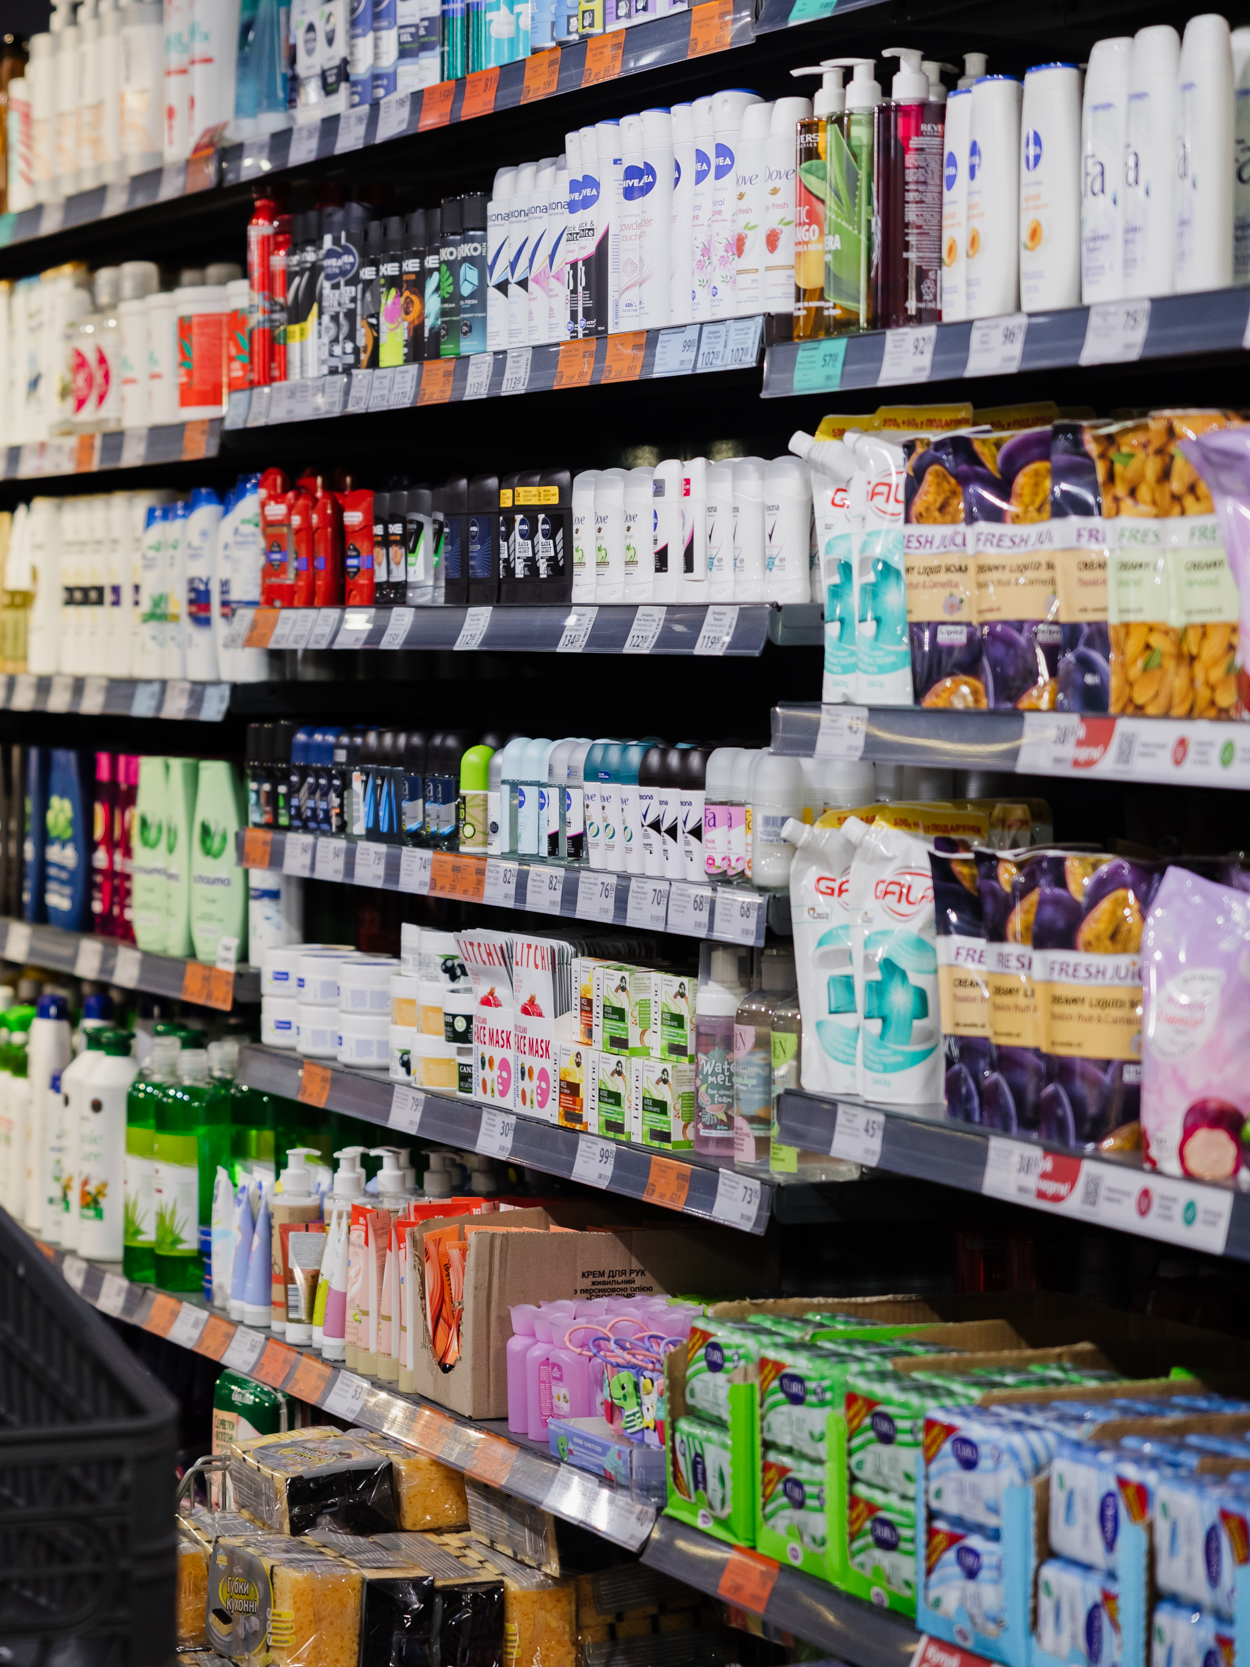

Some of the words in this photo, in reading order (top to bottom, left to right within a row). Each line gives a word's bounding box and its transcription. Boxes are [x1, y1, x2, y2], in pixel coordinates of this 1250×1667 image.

[921, 123, 943, 133] REVE
[695, 162, 708, 171] VEA
[764, 165, 796, 183] Dove
[1083, 152, 1105, 198] Fa
[582, 188, 598, 198] VEA
[509, 208, 528, 219] exona
[528, 204, 548, 215] xona
[548, 200, 569, 212] xona
[771, 202, 790, 211] fresh
[796, 205, 810, 222] TIC
[487, 212, 509, 223] exona
[580, 228, 594, 238] hite
[796, 225, 820, 243] NGO
[461, 242, 481, 257] RKO
[825, 235, 842, 251] ERA
[380, 262, 400, 276] XE
[402, 258, 420, 272] XE
[424, 254, 440, 269] XE
[359, 266, 376, 280] XE
[682, 339, 692, 353] 99
[912, 337, 925, 356] 92
[701, 351, 714, 366] 102
[730, 347, 744, 363] 102
[832, 429, 847, 437] 500
[766, 504, 780, 512] exona
[623, 509, 638, 523] Dove
[373, 524, 384, 536] XE
[1118, 526, 1161, 545] FRES
[1189, 524, 1218, 542] FRE
[905, 534, 933, 550] ESH
[975, 531, 1028, 550] FRESH
[1031, 529, 1053, 547] JUI
[1076, 561, 1107, 572] CREAM
[1022, 577, 1056, 587] amelli
[562, 634, 575, 647] 134
[629, 634, 644, 647] 122
[585, 793, 596, 802] ove
[600, 793, 611, 803] ove
[373, 851, 381, 866] 79
[418, 856, 427, 872] 74
[503, 869, 511, 884] 82
[548, 875, 557, 891] 82
[599, 881, 610, 899] 76
[651, 888, 662, 906] 70
[693, 894, 704, 912] 68
[740, 900, 751, 918] 68
[456, 939, 502, 967] LITCHI
[515, 942, 550, 972] LITCHI
[955, 946, 987, 964] FRE
[1050, 960, 1107, 980] FRESH
[953, 977, 988, 988] CREAM
[992, 986, 1019, 997] REAMY
[1050, 994, 1085, 1006] REAMY
[1050, 1012, 1073, 1021] ssion
[1102, 1014, 1142, 1026] Camelli
[474, 1023, 487, 1045] FACE
[488, 1027, 511, 1049] MASK
[514, 1032, 527, 1055] FACE
[528, 1036, 550, 1060] MASK
[701, 1059, 736, 1076] Wate
[409, 1096, 418, 1112] 79
[714, 1095, 732, 1104] foam
[499, 1120, 510, 1137] 30
[864, 1118, 876, 1138] 45
[599, 1147, 609, 1165] 99
[742, 1185, 753, 1205] 73
[581, 1270, 605, 1279] КРЕМ
[607, 1269, 626, 1279] ДЛЯ
[629, 1268, 646, 1277] РУК
[591, 1278, 636, 1286] живильний
[579, 1287, 628, 1295] персиковою
[351, 1385, 363, 1401] 53
[782, 1377, 805, 1396] DURU
[573, 1436, 583, 1445] HAND
[225, 1576, 249, 1598] Губки
[225, 1597, 258, 1616] кухонні
